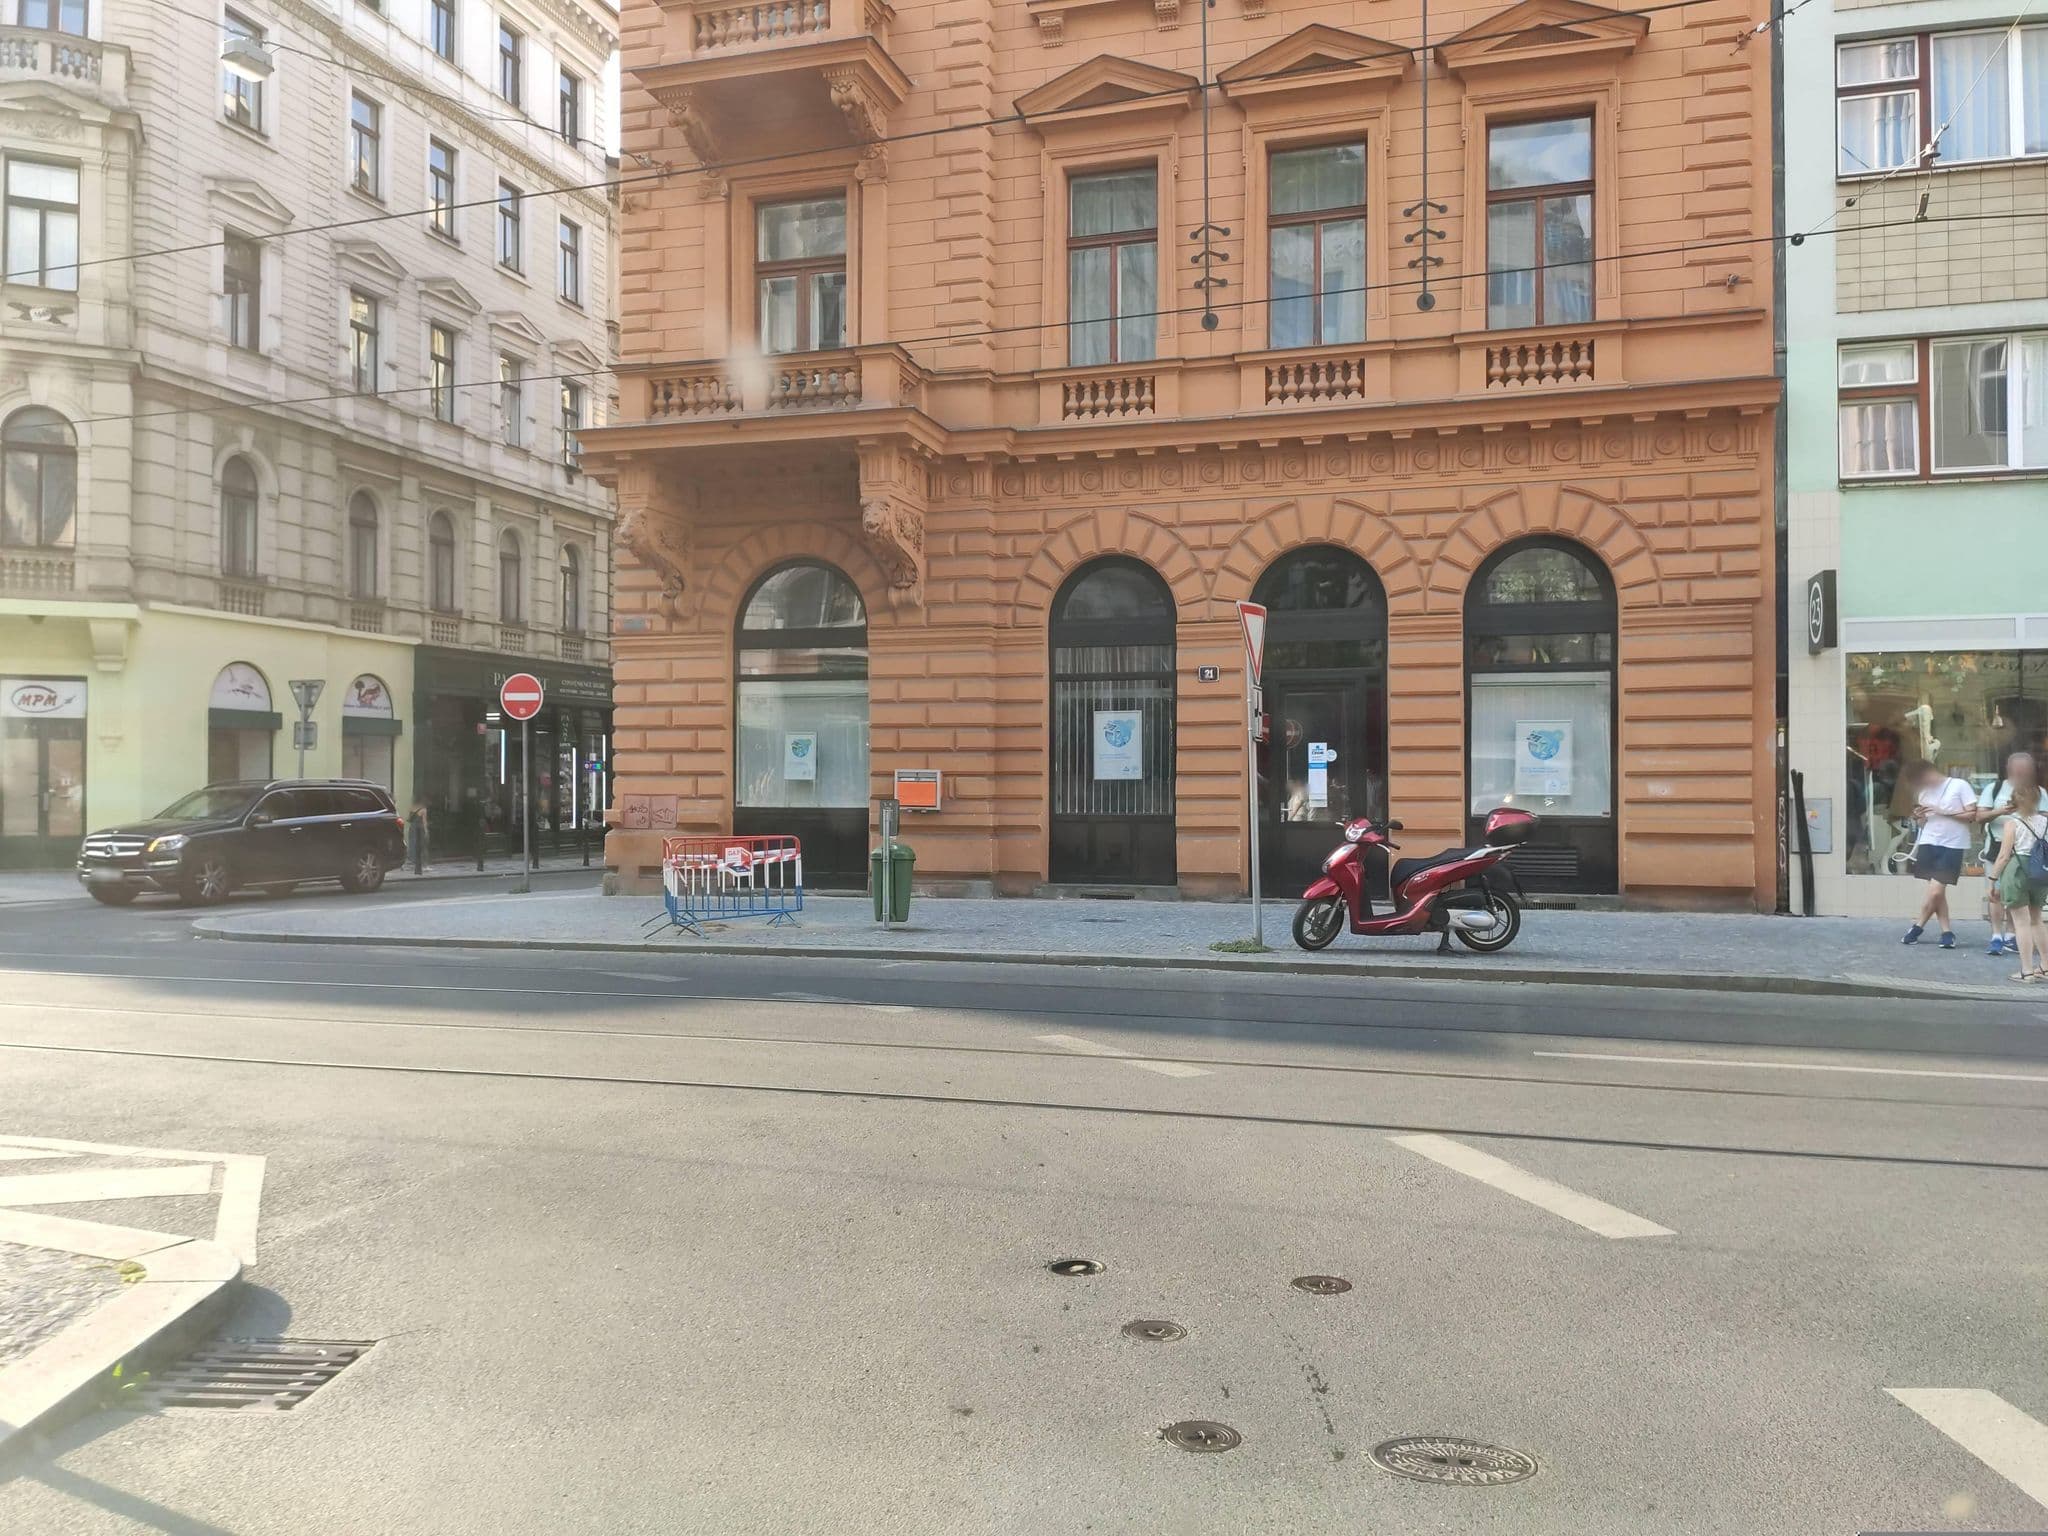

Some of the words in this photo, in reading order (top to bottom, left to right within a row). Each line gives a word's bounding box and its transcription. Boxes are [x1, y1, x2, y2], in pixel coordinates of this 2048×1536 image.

[1811, 597, 1821, 626] 23
[1204, 669, 1214, 679] 21
[17, 693, 57, 706] MPM
